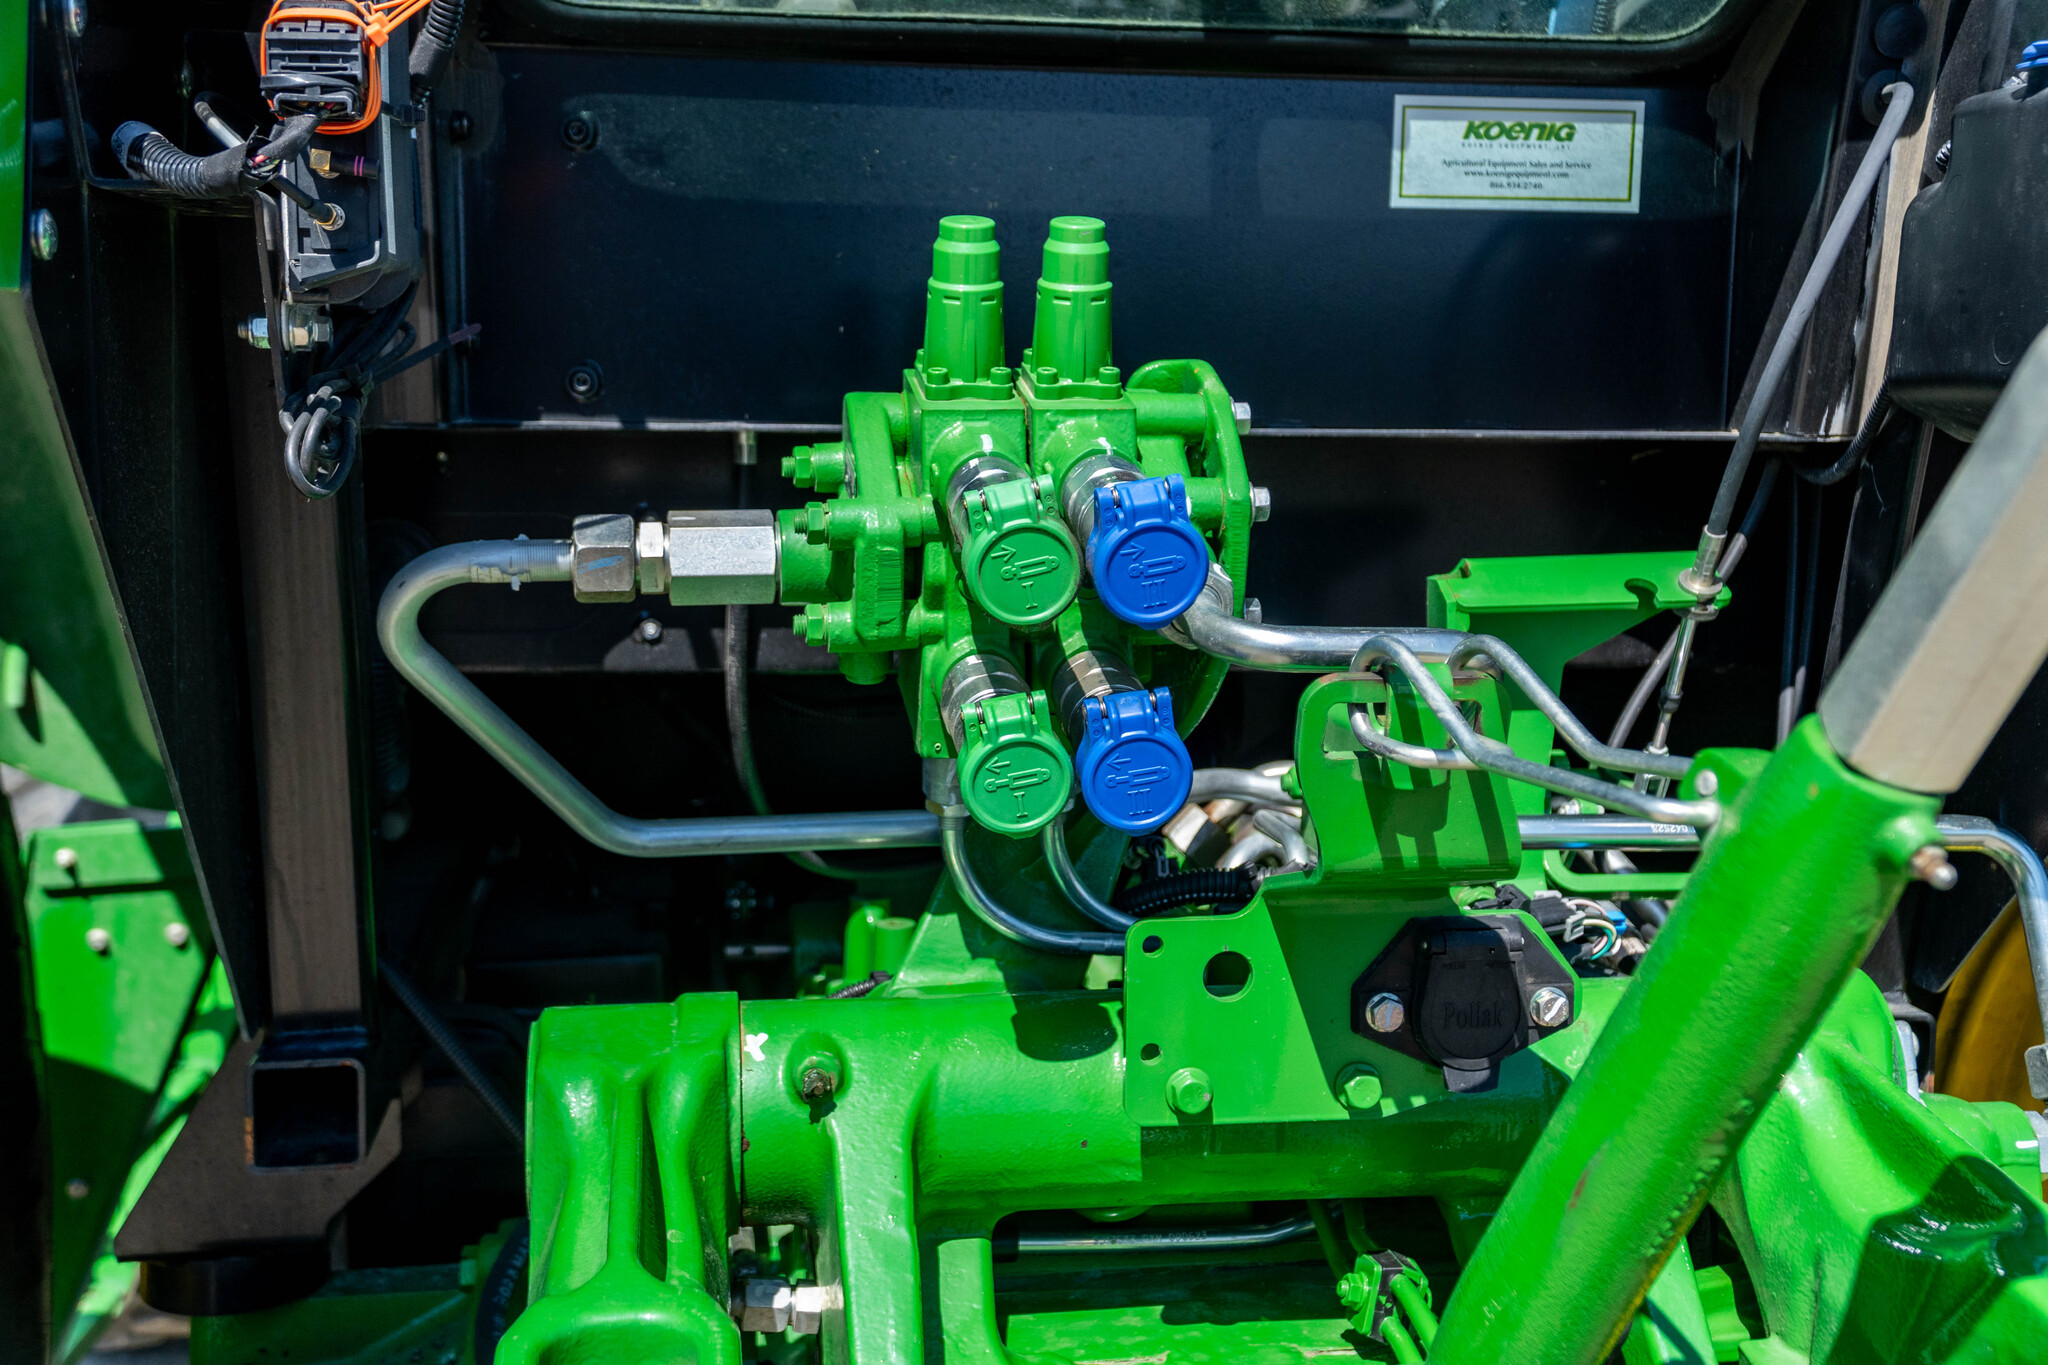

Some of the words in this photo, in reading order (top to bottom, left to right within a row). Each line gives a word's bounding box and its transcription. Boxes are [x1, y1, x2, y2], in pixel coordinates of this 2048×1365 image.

[1442, 158, 1485, 168] Agricultural
[1488, 159, 1527, 170] Equipment
[1529, 160, 1547, 168] Sales
[1549, 161, 1563, 169] and
[1565, 161, 1592, 169] Service
[1464, 169, 1570, 179] www.koenigequipment.com
[1443, 1000, 1505, 1030] Pollak
